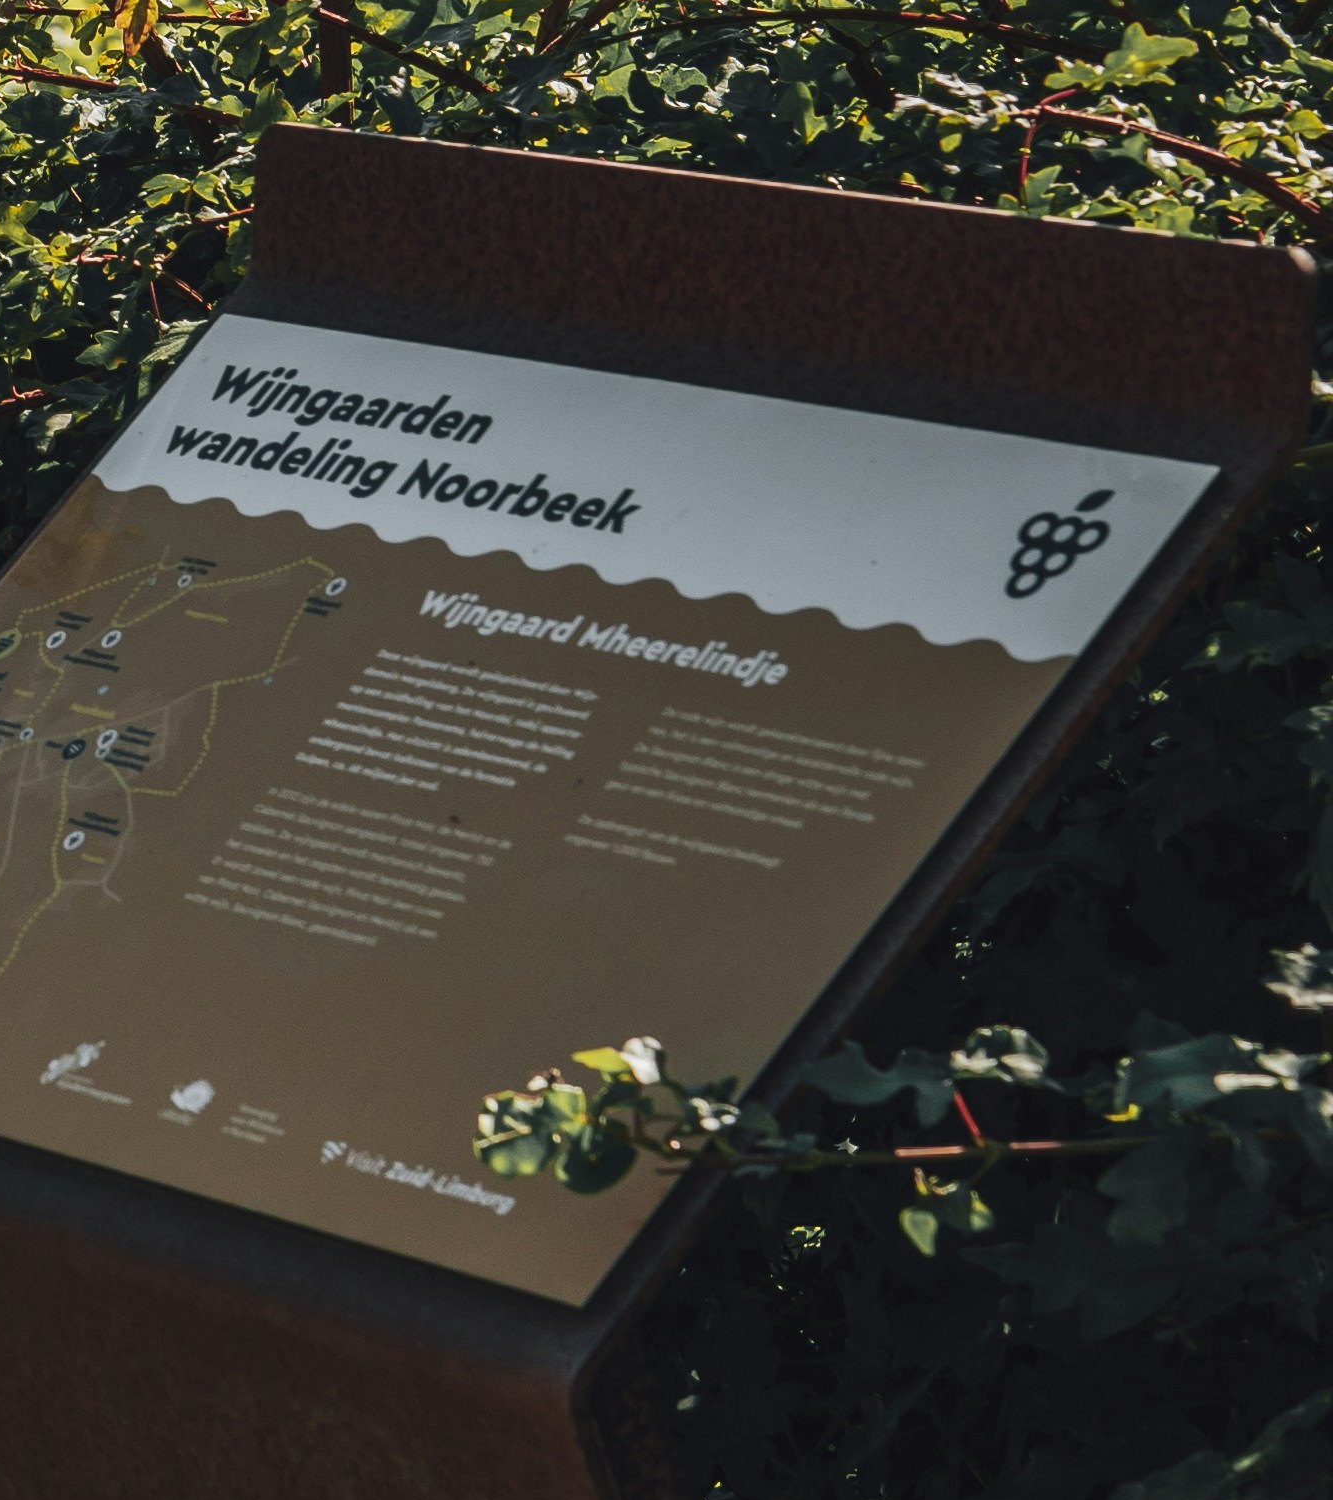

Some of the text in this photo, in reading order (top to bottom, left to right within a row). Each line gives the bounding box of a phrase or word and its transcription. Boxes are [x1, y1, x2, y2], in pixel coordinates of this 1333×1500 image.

[211, 364, 493, 445] Wijngaarden
[166, 424, 641, 534] wandeling Noorbeek
[419, 589, 789, 688] Wijngaard Mheerelindje
